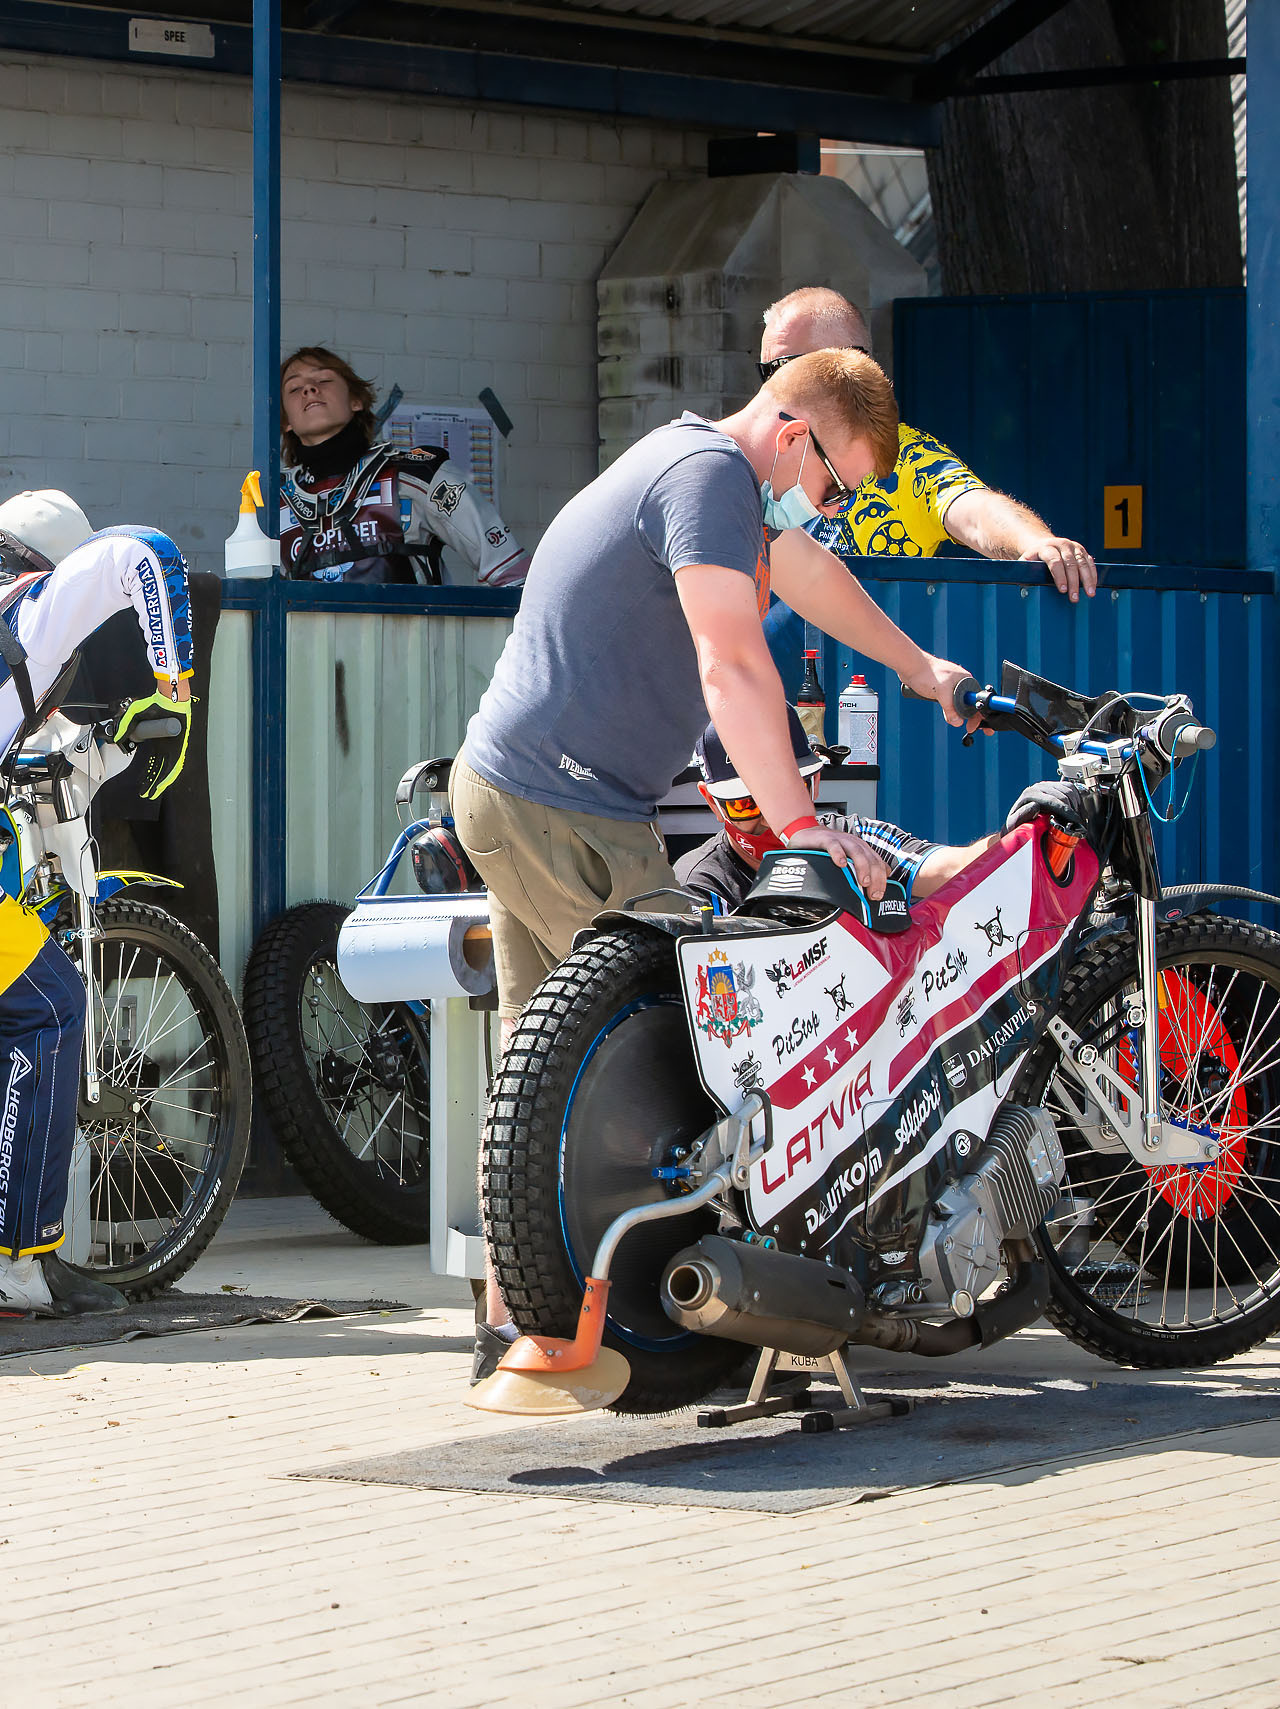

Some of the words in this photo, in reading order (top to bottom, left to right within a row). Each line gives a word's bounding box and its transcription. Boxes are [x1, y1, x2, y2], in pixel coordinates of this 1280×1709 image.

[164, 30, 186, 42] SPEE
[292, 495, 313, 517] moveo
[1115, 498, 1128, 536] 1
[139, 559, 163, 643] BILVERKSTAD
[772, 867, 806, 875] ERGOSS
[789, 936, 828, 980] LaMSF
[772, 1011, 820, 1064] PitStop
[967, 1001, 1036, 1067] DAUGAVPILS
[760, 1060, 874, 1194] LATVIA
[791, 1356, 819, 1367] KUBA
